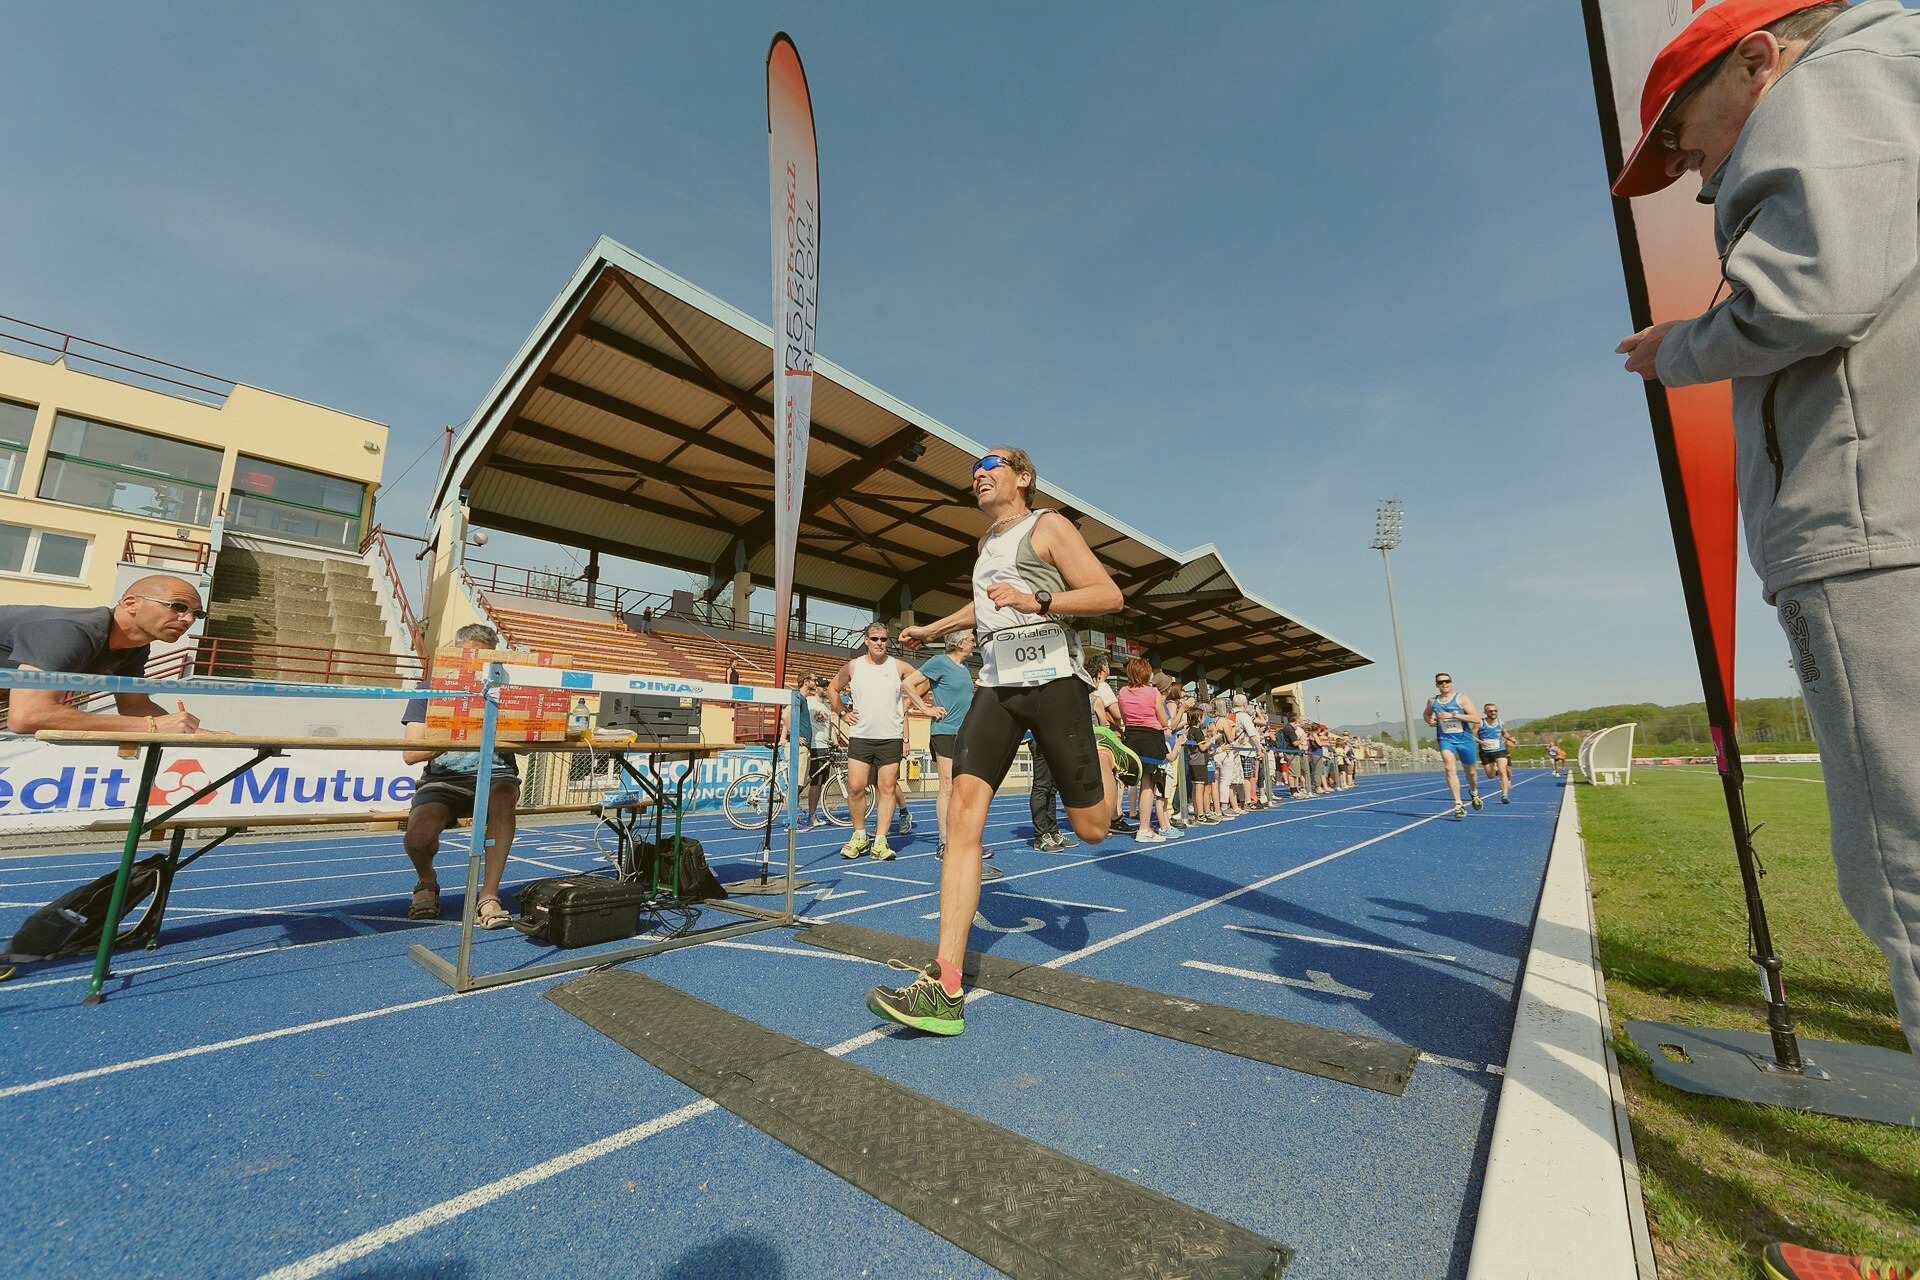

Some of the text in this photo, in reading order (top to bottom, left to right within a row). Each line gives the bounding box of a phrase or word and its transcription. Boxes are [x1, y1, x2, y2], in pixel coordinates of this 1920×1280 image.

[1017, 628, 1063, 639] Kalenji
[1015, 645, 1047, 662] 031
[629, 680, 692, 694] DIMA
